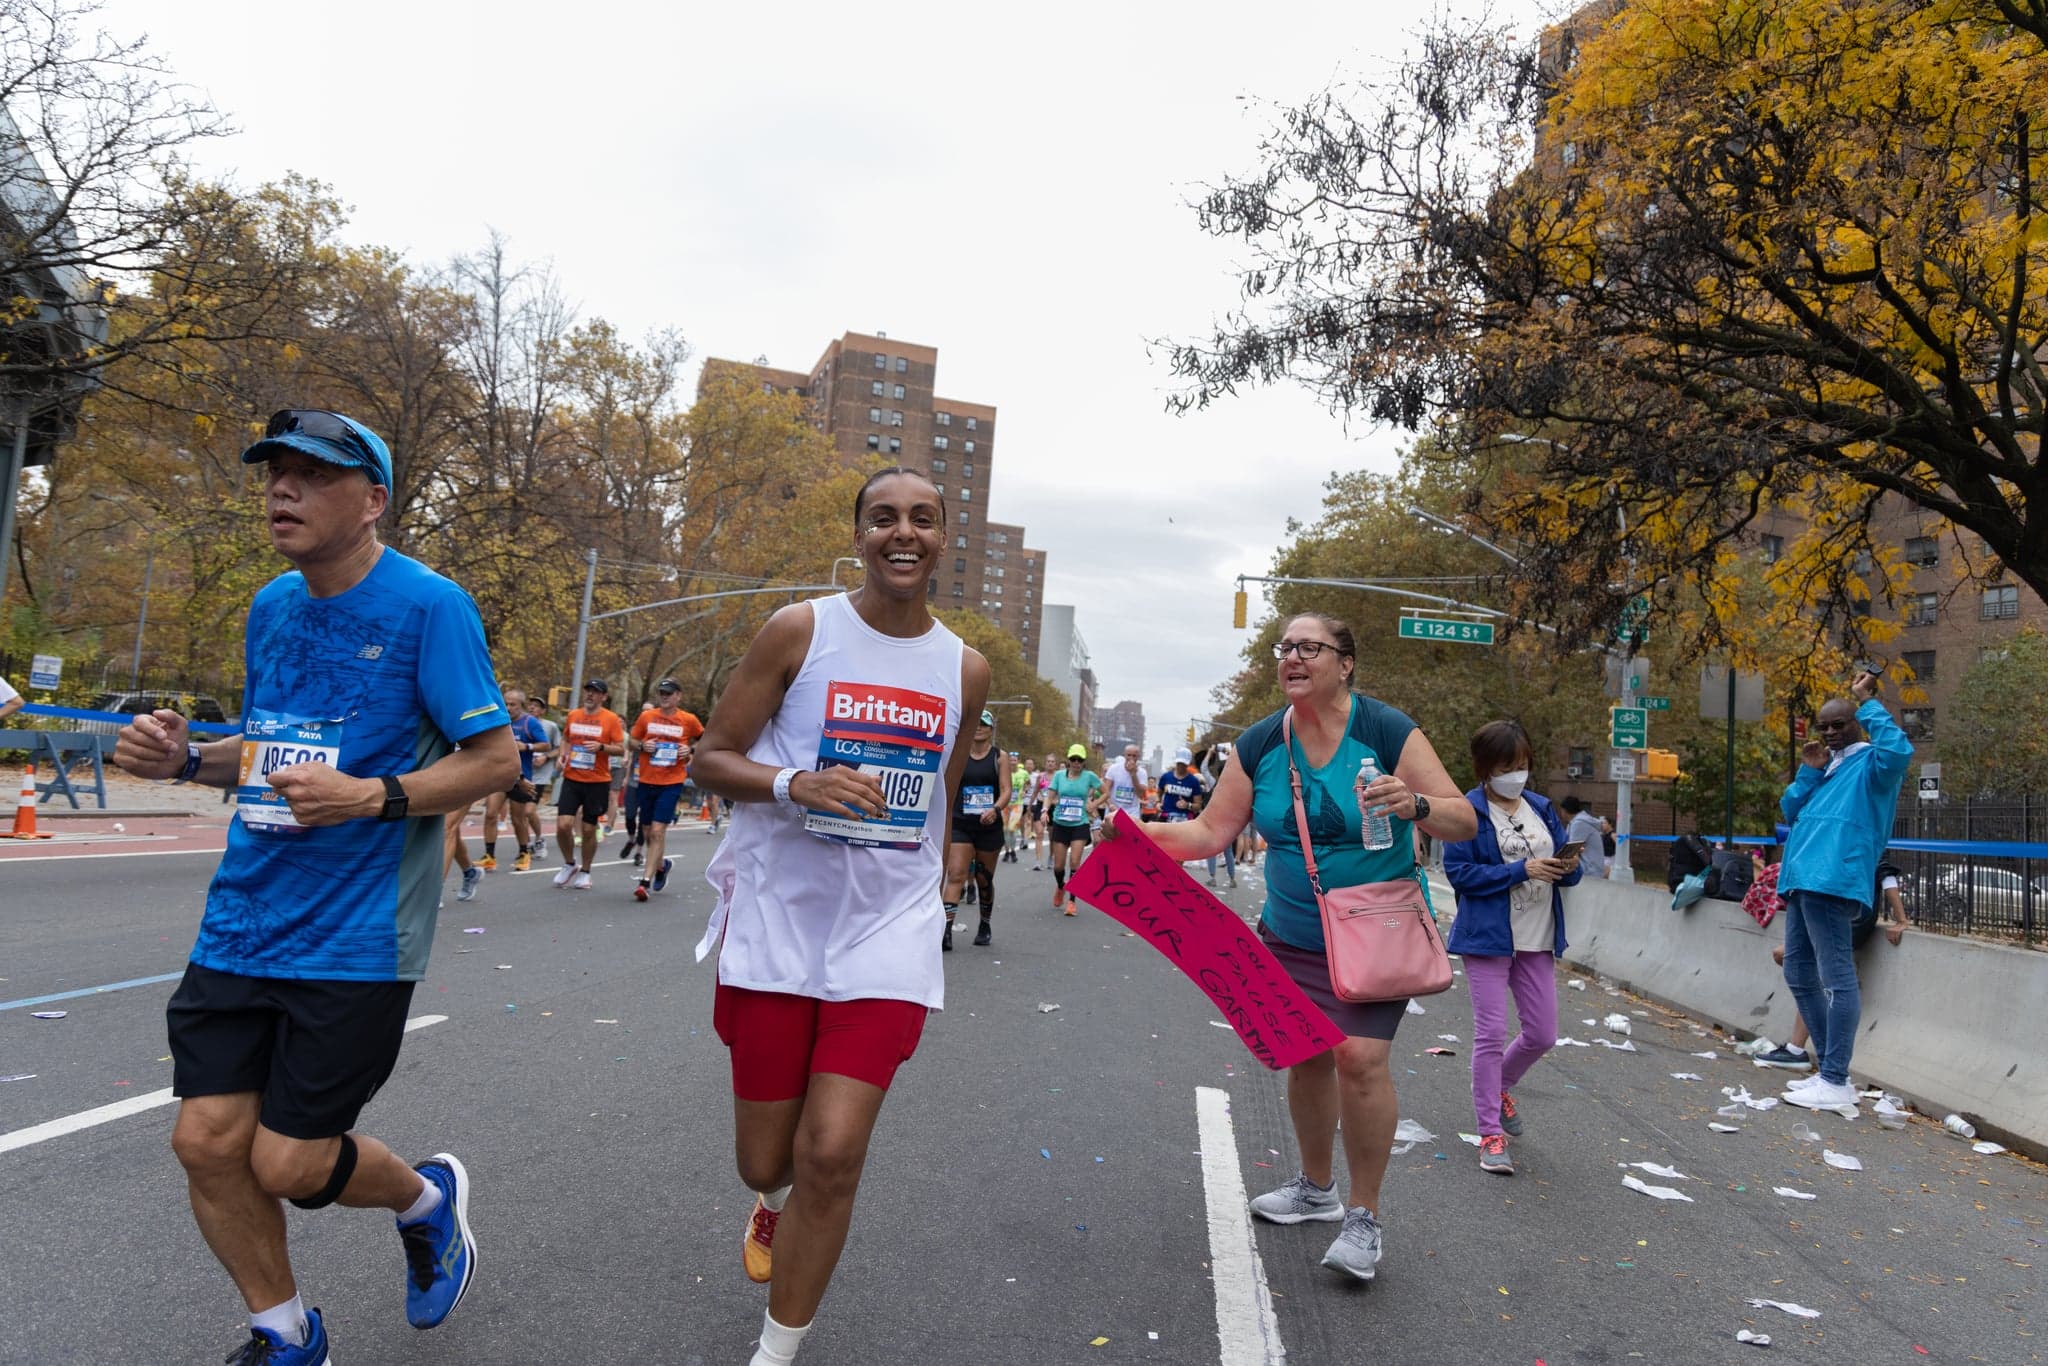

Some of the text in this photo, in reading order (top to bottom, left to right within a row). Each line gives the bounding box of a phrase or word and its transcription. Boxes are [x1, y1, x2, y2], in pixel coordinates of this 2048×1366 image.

[1414, 622, 1480, 638] E 124 St
[1645, 698, 1658, 708] 124
[833, 693, 942, 738] Brittany
[297, 731, 322, 740] TATA
[864, 752, 886, 760] SERVICES
[907, 756, 926, 766] TATA
[809, 818, 873, 832] #TCSNYCMarathon
[1093, 864, 1282, 1070] YOUR GARMIN
[1216, 952, 1291, 1045] PAUSE
[1236, 937, 1328, 1048] COLLAPSE
